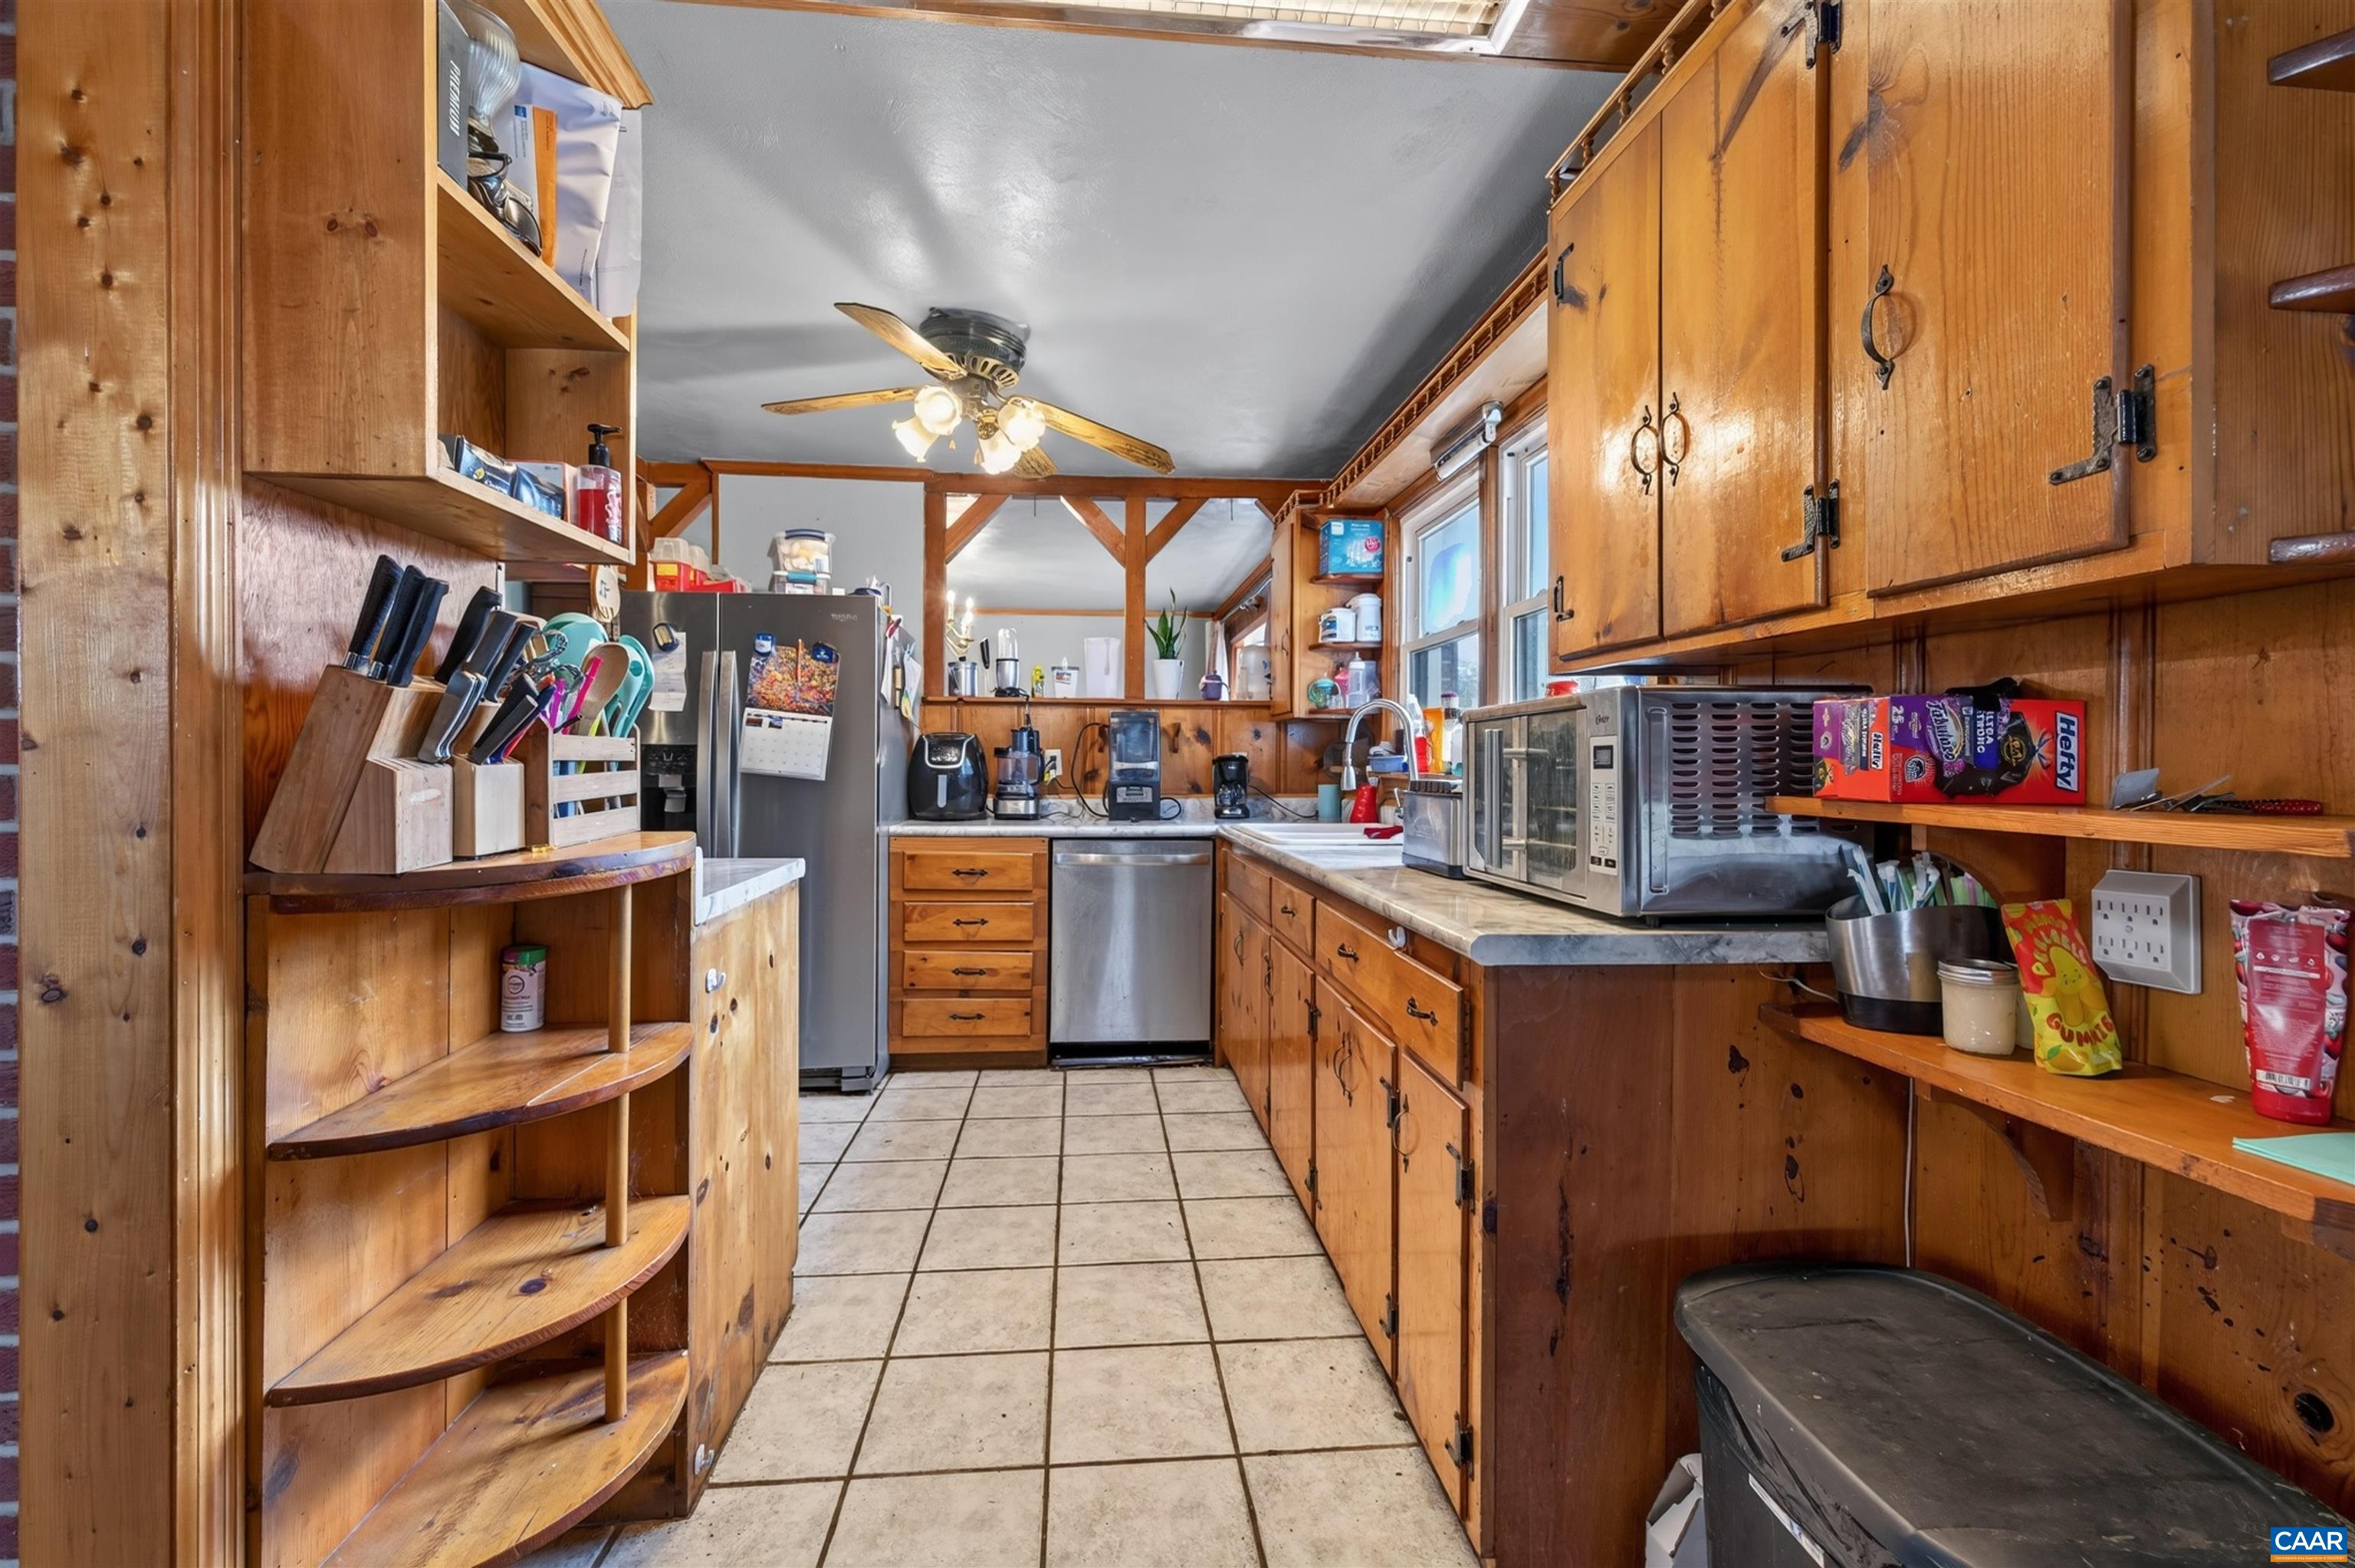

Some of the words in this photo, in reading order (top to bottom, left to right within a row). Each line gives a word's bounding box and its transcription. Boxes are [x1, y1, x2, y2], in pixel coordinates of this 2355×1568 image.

[449, 60, 461, 136] PREMIUM
[1890, 705, 1904, 724] 25
[2057, 716, 2076, 788] Hefty
